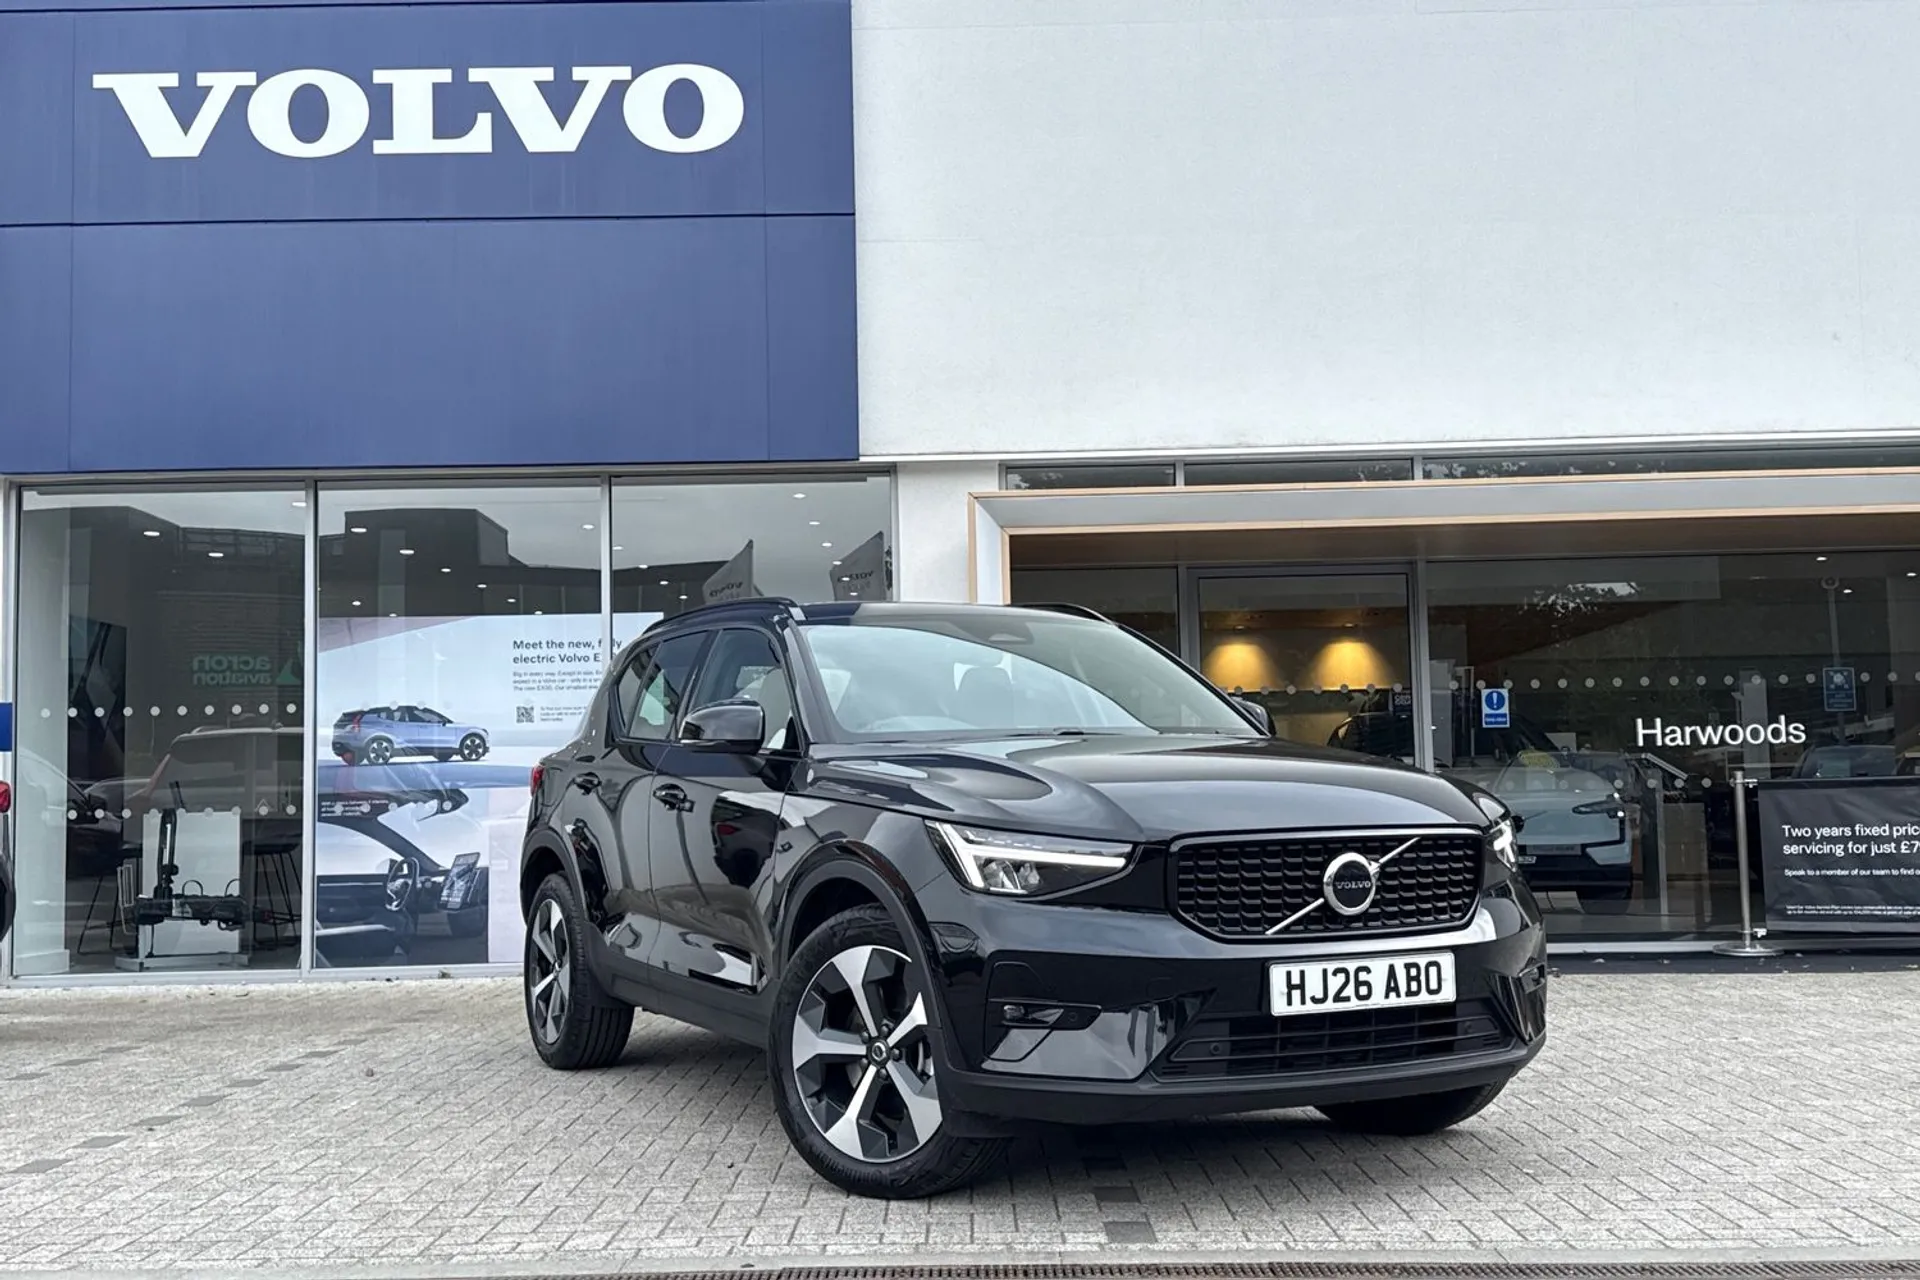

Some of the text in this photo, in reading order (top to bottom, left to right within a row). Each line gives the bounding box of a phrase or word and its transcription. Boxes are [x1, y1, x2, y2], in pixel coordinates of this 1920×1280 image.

[92, 63, 744, 158] VOLVO
[513, 640, 543, 650] Meet
[546, 639, 564, 649] the
[568, 640, 595, 650] new,
[513, 653, 556, 664] electric
[559, 653, 590, 663] Volvo
[1636, 714, 1806, 747] Harwoods
[1782, 825, 1812, 837] Two
[1814, 826, 1852, 839] years
[1855, 823, 1890, 836] fixed
[1783, 840, 1920, 857] servicing for just £7
[1784, 868, 1806, 877] Speak
[1821, 868, 1850, 876] member
[1851, 868, 1859, 876] of
[1872, 868, 1891, 876] team
[1900, 867, 1915, 875] find
[1336, 880, 1371, 890] VOLVO
[1286, 960, 1442, 1007] HJ26 ABO
